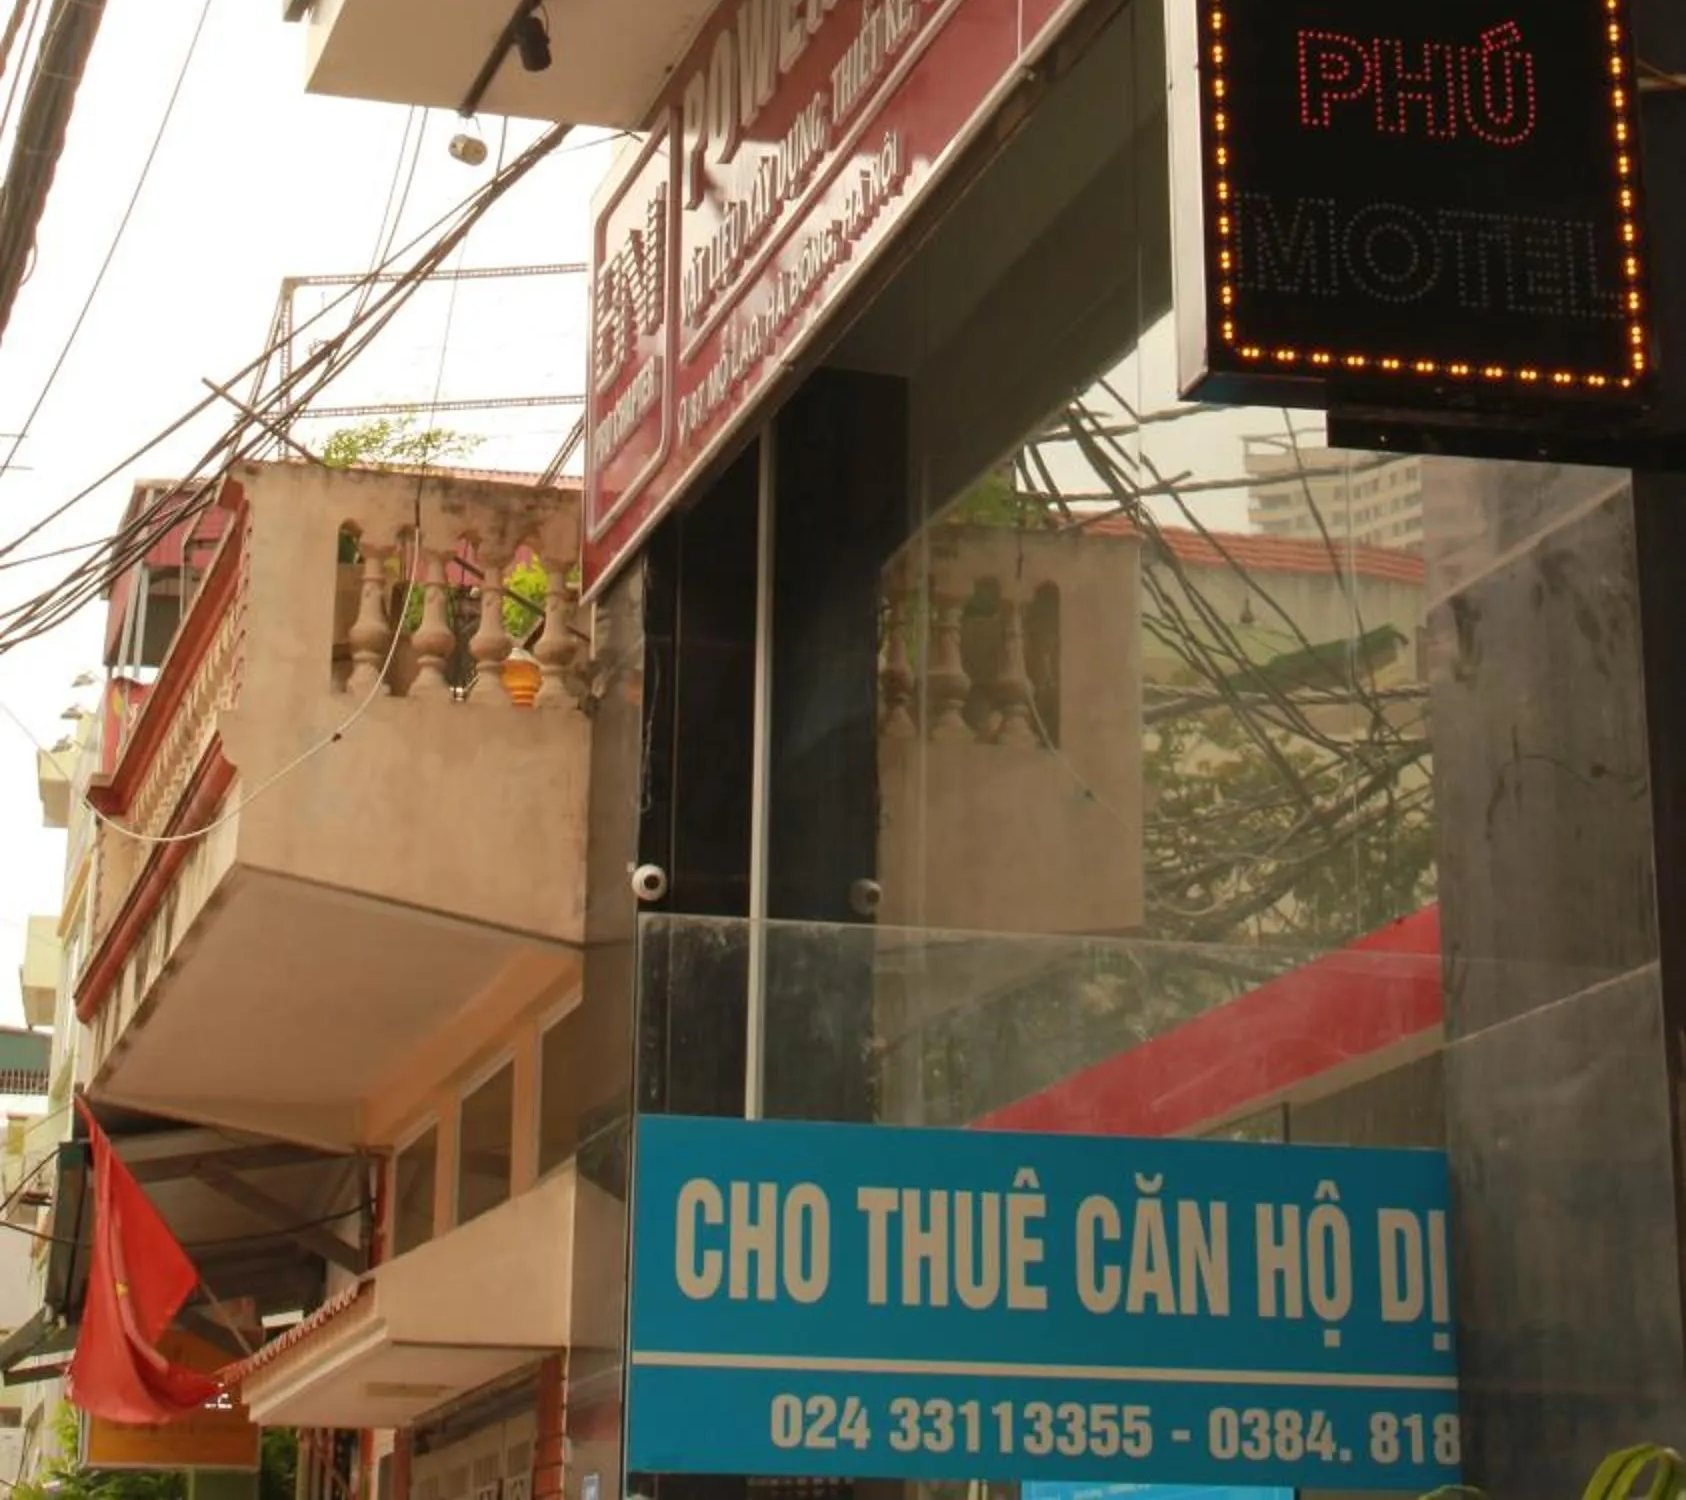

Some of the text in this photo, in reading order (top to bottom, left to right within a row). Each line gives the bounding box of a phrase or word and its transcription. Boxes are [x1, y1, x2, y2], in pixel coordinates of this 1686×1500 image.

[1298, 21, 1536, 145] PHÚ
[1234, 192, 1624, 318] MOTEL
[675, 1166, 1451, 1351] CHO THUÊ CĂN HỘ DỊ
[769, 1394, 871, 1449] 024
[889, 1396, 1153, 1457] 33113355
[1208, 1407, 1353, 1462] 0384.
[1370, 1411, 1461, 1465] 818
